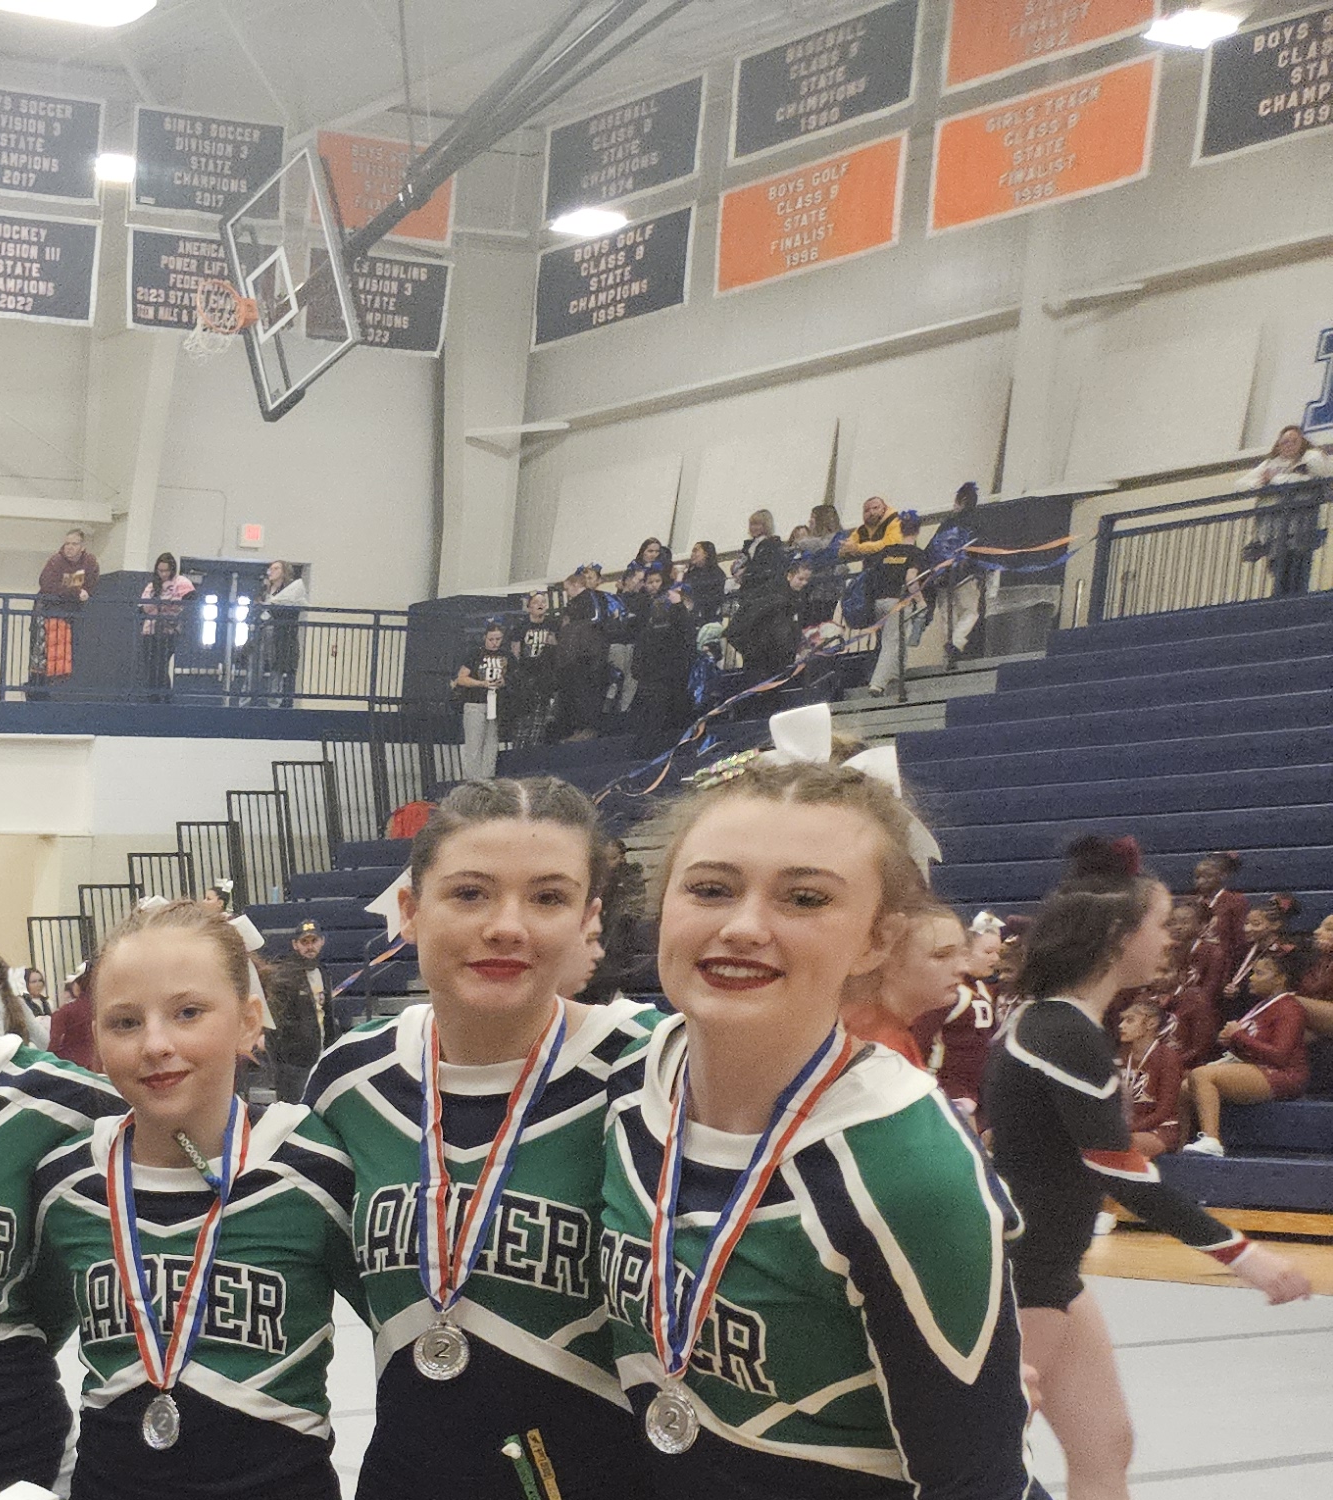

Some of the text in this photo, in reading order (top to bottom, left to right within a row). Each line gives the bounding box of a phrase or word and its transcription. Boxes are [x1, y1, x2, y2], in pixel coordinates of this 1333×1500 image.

[1254, 22, 1310, 54] BOYS
[1278, 36, 1333, 69] CLAS
[19, 99, 73, 119] SOCCER
[986, 82, 1102, 133] GIRLS TRACK
[1258, 82, 1333, 117] CHAMP
[1294, 103, 1333, 129] 199
[0, 133, 45, 152] STATE
[163, 116, 261, 143] GIRLS SOCCER
[1003, 119, 1060, 148] CLASS
[175, 136, 233, 158] DIVISION
[602, 140, 641, 164] STATE
[1013, 136, 1066, 166] STATE
[2, 169, 37, 187] 2017
[189, 156, 232, 175] STATE
[582, 152, 659, 188] CHAMPIONS
[998, 153, 1077, 189] FINALIST
[173, 171, 248, 193] CHAMPIONS
[768, 162, 851, 200] BOYS GOLF
[195, 191, 224, 208] 2017
[777, 190, 822, 216] CLASS
[784, 207, 828, 232] STATE
[178, 239, 225, 258] AMERICA
[573, 224, 655, 263] BOYS GOLF
[770, 224, 835, 255] FINALIST
[44, 246, 61, 261] III
[161, 255, 197, 272] POWER
[581, 251, 626, 276] CLASS
[375, 262, 428, 281] BOWLING
[589, 265, 632, 291] STATE
[169, 290, 205, 307] STAT
[404, 282, 413, 296] 3
[568, 279, 649, 314] CHAMPIONS
[366, 328, 390, 343] 023
[351, 1181, 591, 1300] AER
[73, 1252, 287, 1356] AEER
